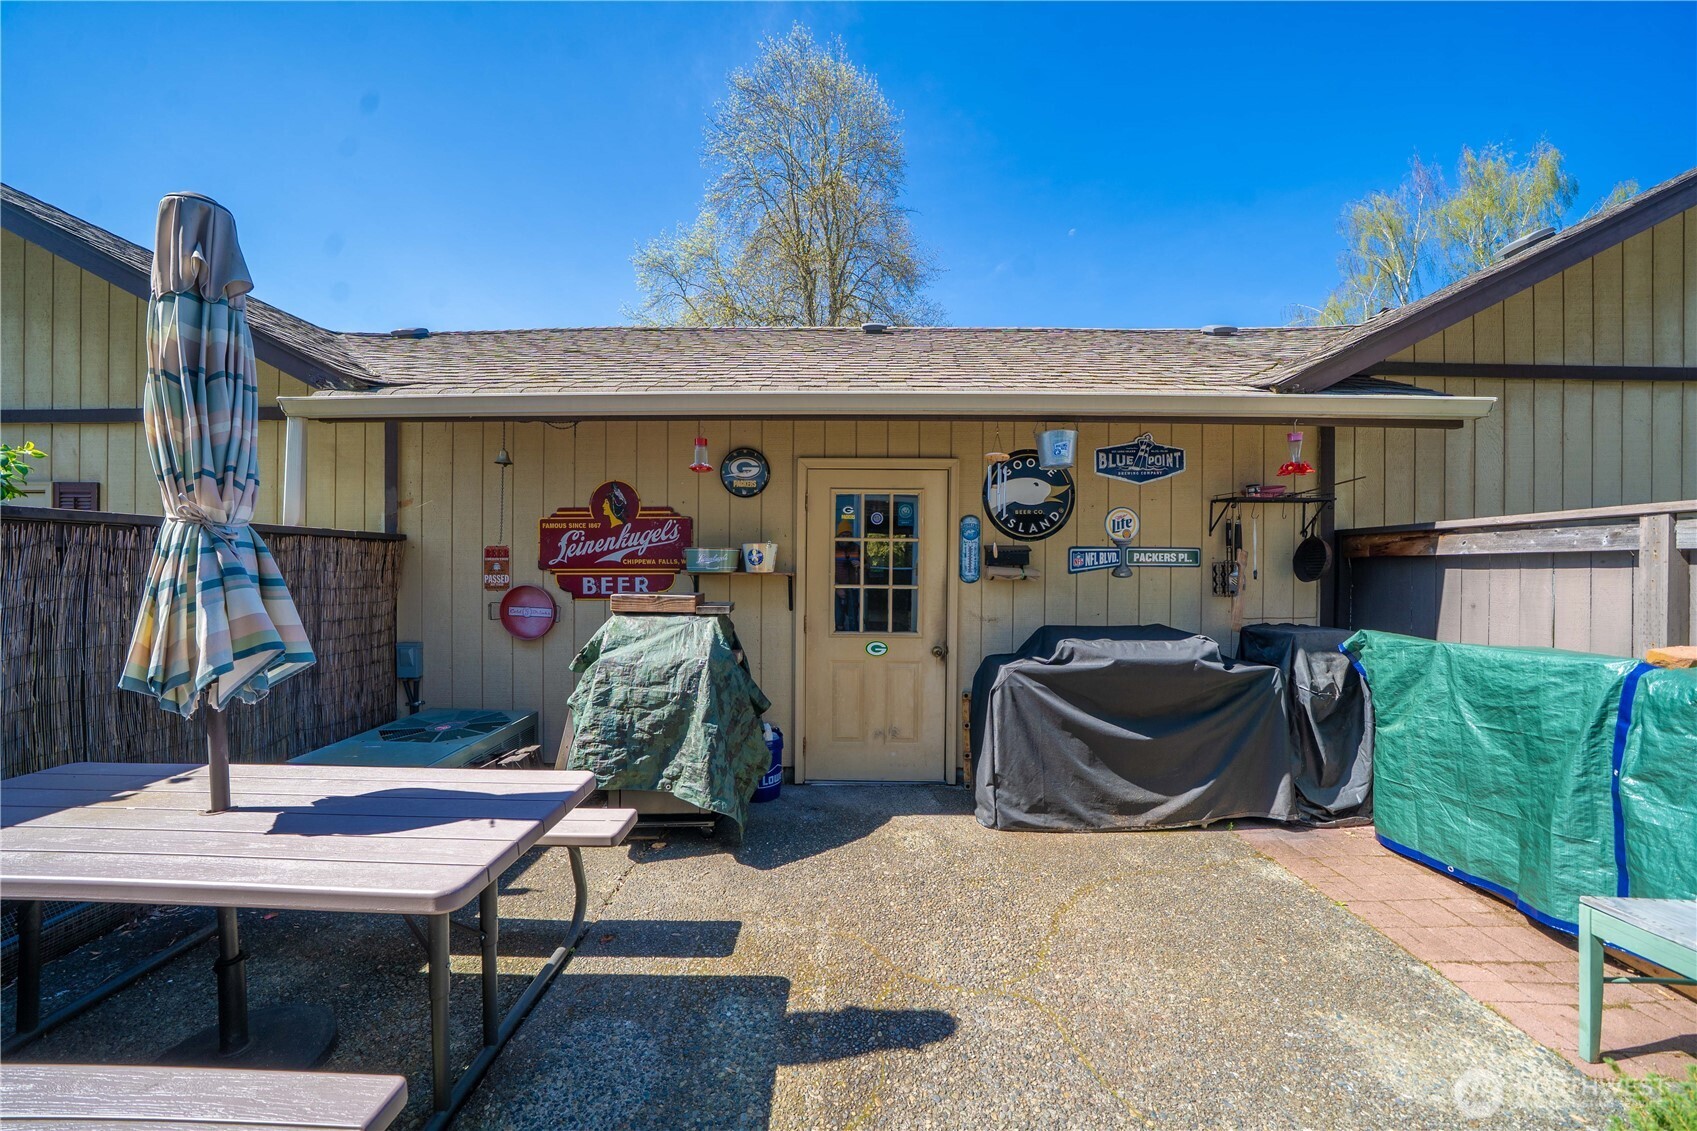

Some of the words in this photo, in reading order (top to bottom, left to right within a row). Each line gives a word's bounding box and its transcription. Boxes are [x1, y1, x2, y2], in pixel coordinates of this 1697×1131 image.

[1003, 458, 1057, 477] GOOE
[1098, 452, 1134, 469] BLUE
[1148, 452, 1180, 468] POINT
[1001, 511, 1059, 533] ISLAND
[1112, 518, 1132, 533] Lite
[549, 520, 680, 565] Leinenkugel's
[1085, 552, 1098, 566] NFL
[1099, 552, 1119, 564] BLVD.
[1133, 553, 1176, 562] PACKERS
[1178, 553, 1192, 562] PL.
[484, 574, 510, 584] PASSED
[582, 577, 649, 594] BEER
